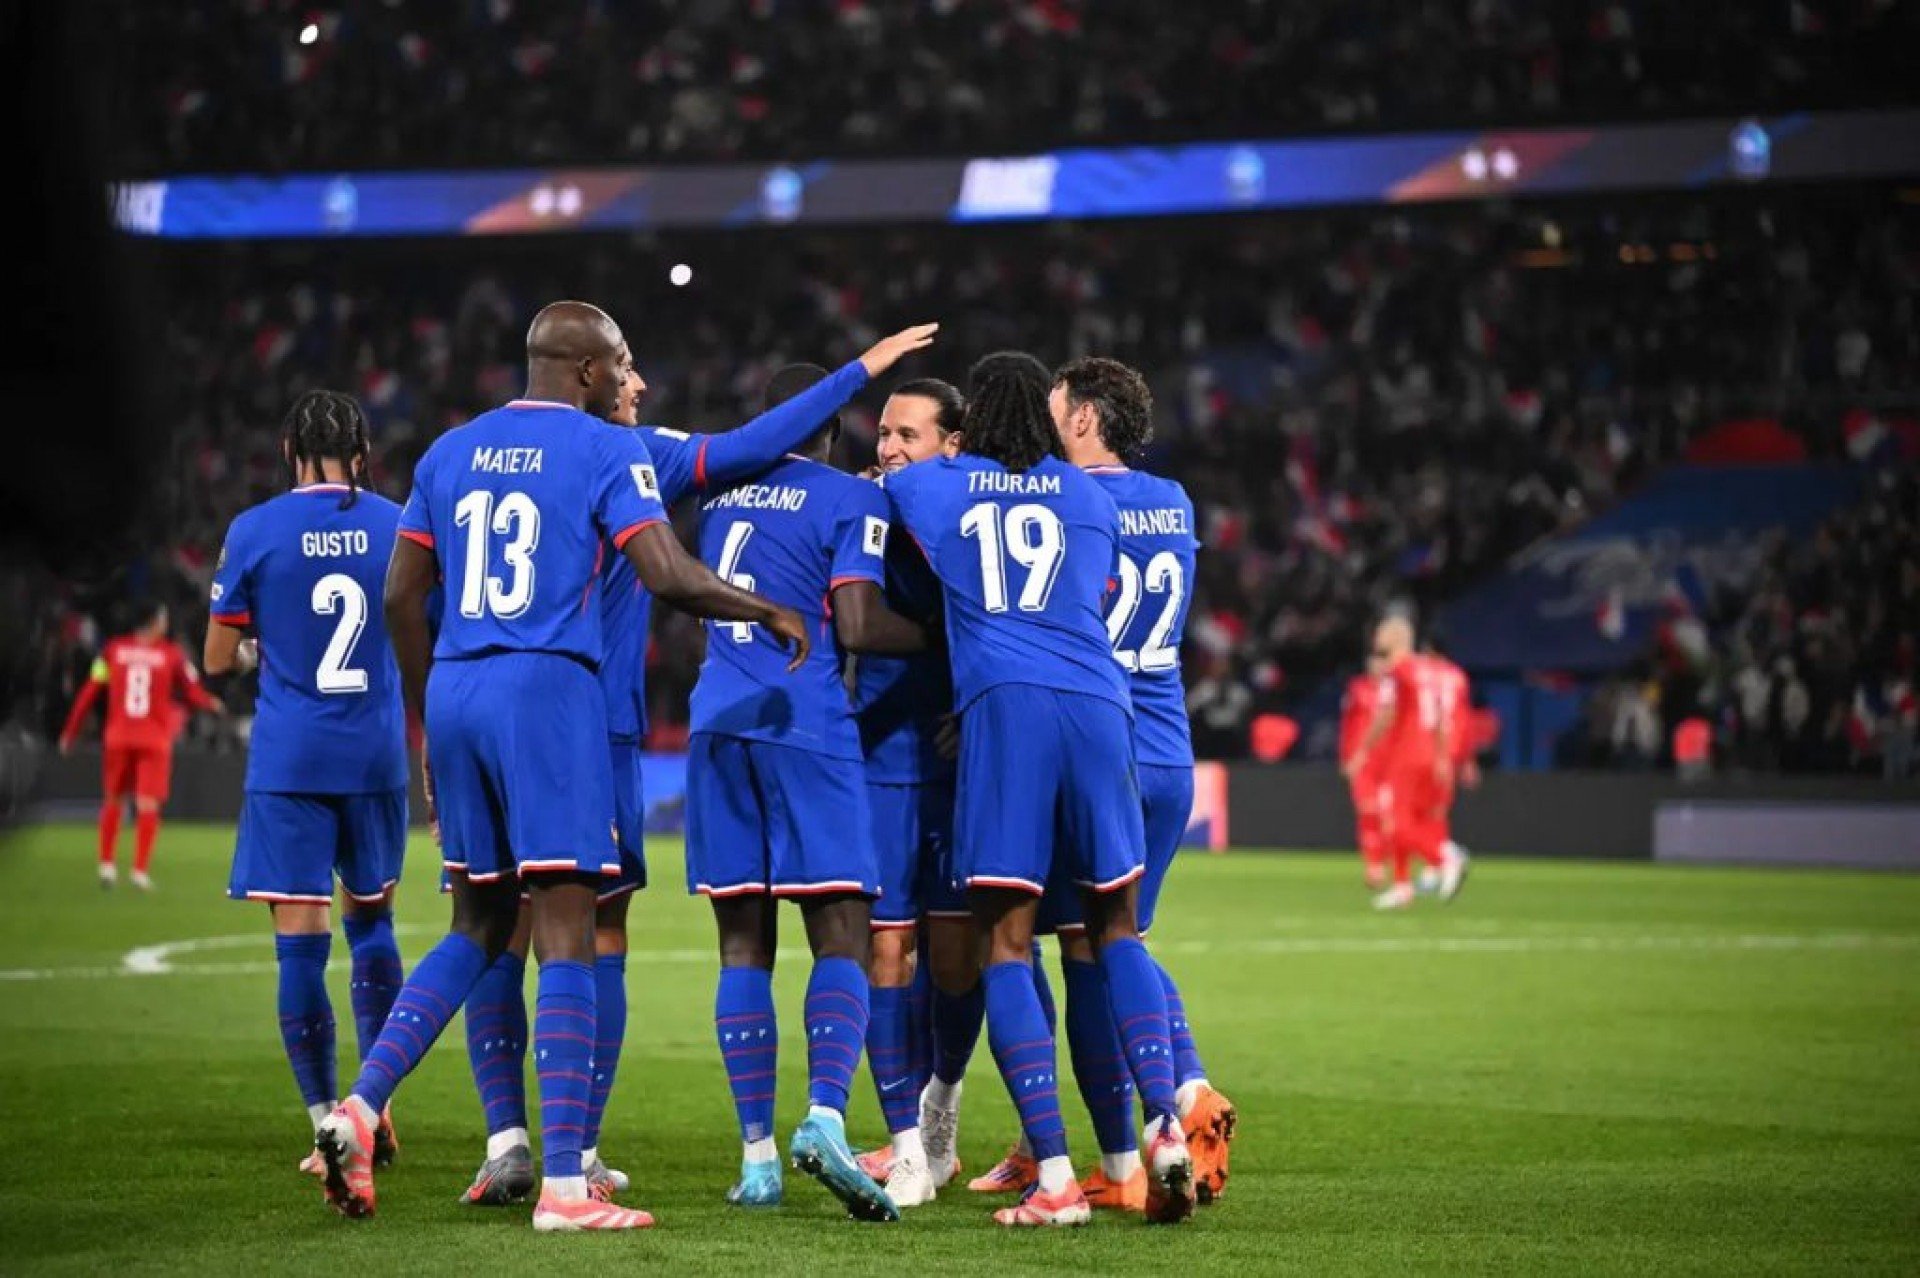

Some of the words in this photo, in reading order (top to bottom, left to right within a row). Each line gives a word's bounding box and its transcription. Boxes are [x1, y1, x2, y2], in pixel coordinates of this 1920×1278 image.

[471, 445, 543, 474] MATETA
[967, 469, 1062, 494] THURAM
[302, 529, 369, 557] GUSTO
[455, 489, 540, 619] 13
[959, 501, 1066, 613] 19
[312, 573, 368, 693] 2
[1105, 551, 1184, 673] 22
[125, 667, 150, 718] 8
